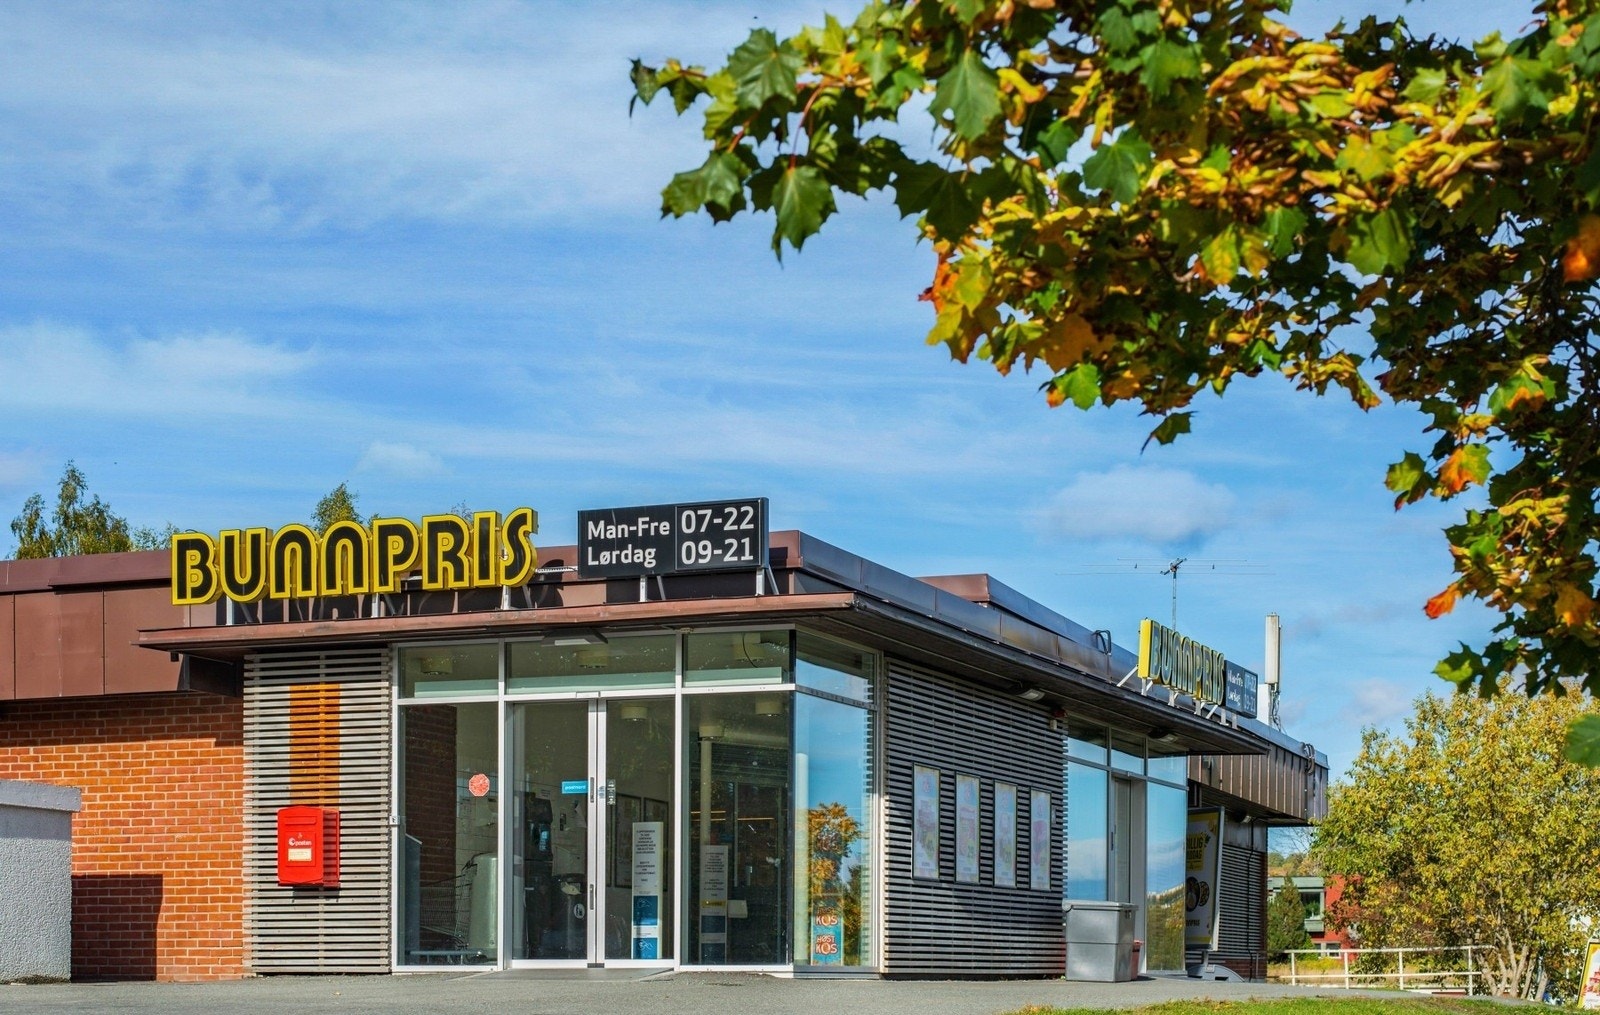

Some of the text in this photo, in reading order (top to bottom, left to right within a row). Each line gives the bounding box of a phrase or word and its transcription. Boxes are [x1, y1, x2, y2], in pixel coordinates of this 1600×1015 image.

[587, 505, 755, 541] Man-Fre 07-22
[171, 507, 538, 606] BUNNPRIS
[587, 537, 754, 568] Lørdag 09-21
[1149, 620, 1225, 706] BUNNPRIS
[816, 915, 838, 926] KOS
[815, 943, 838, 955] KOS
